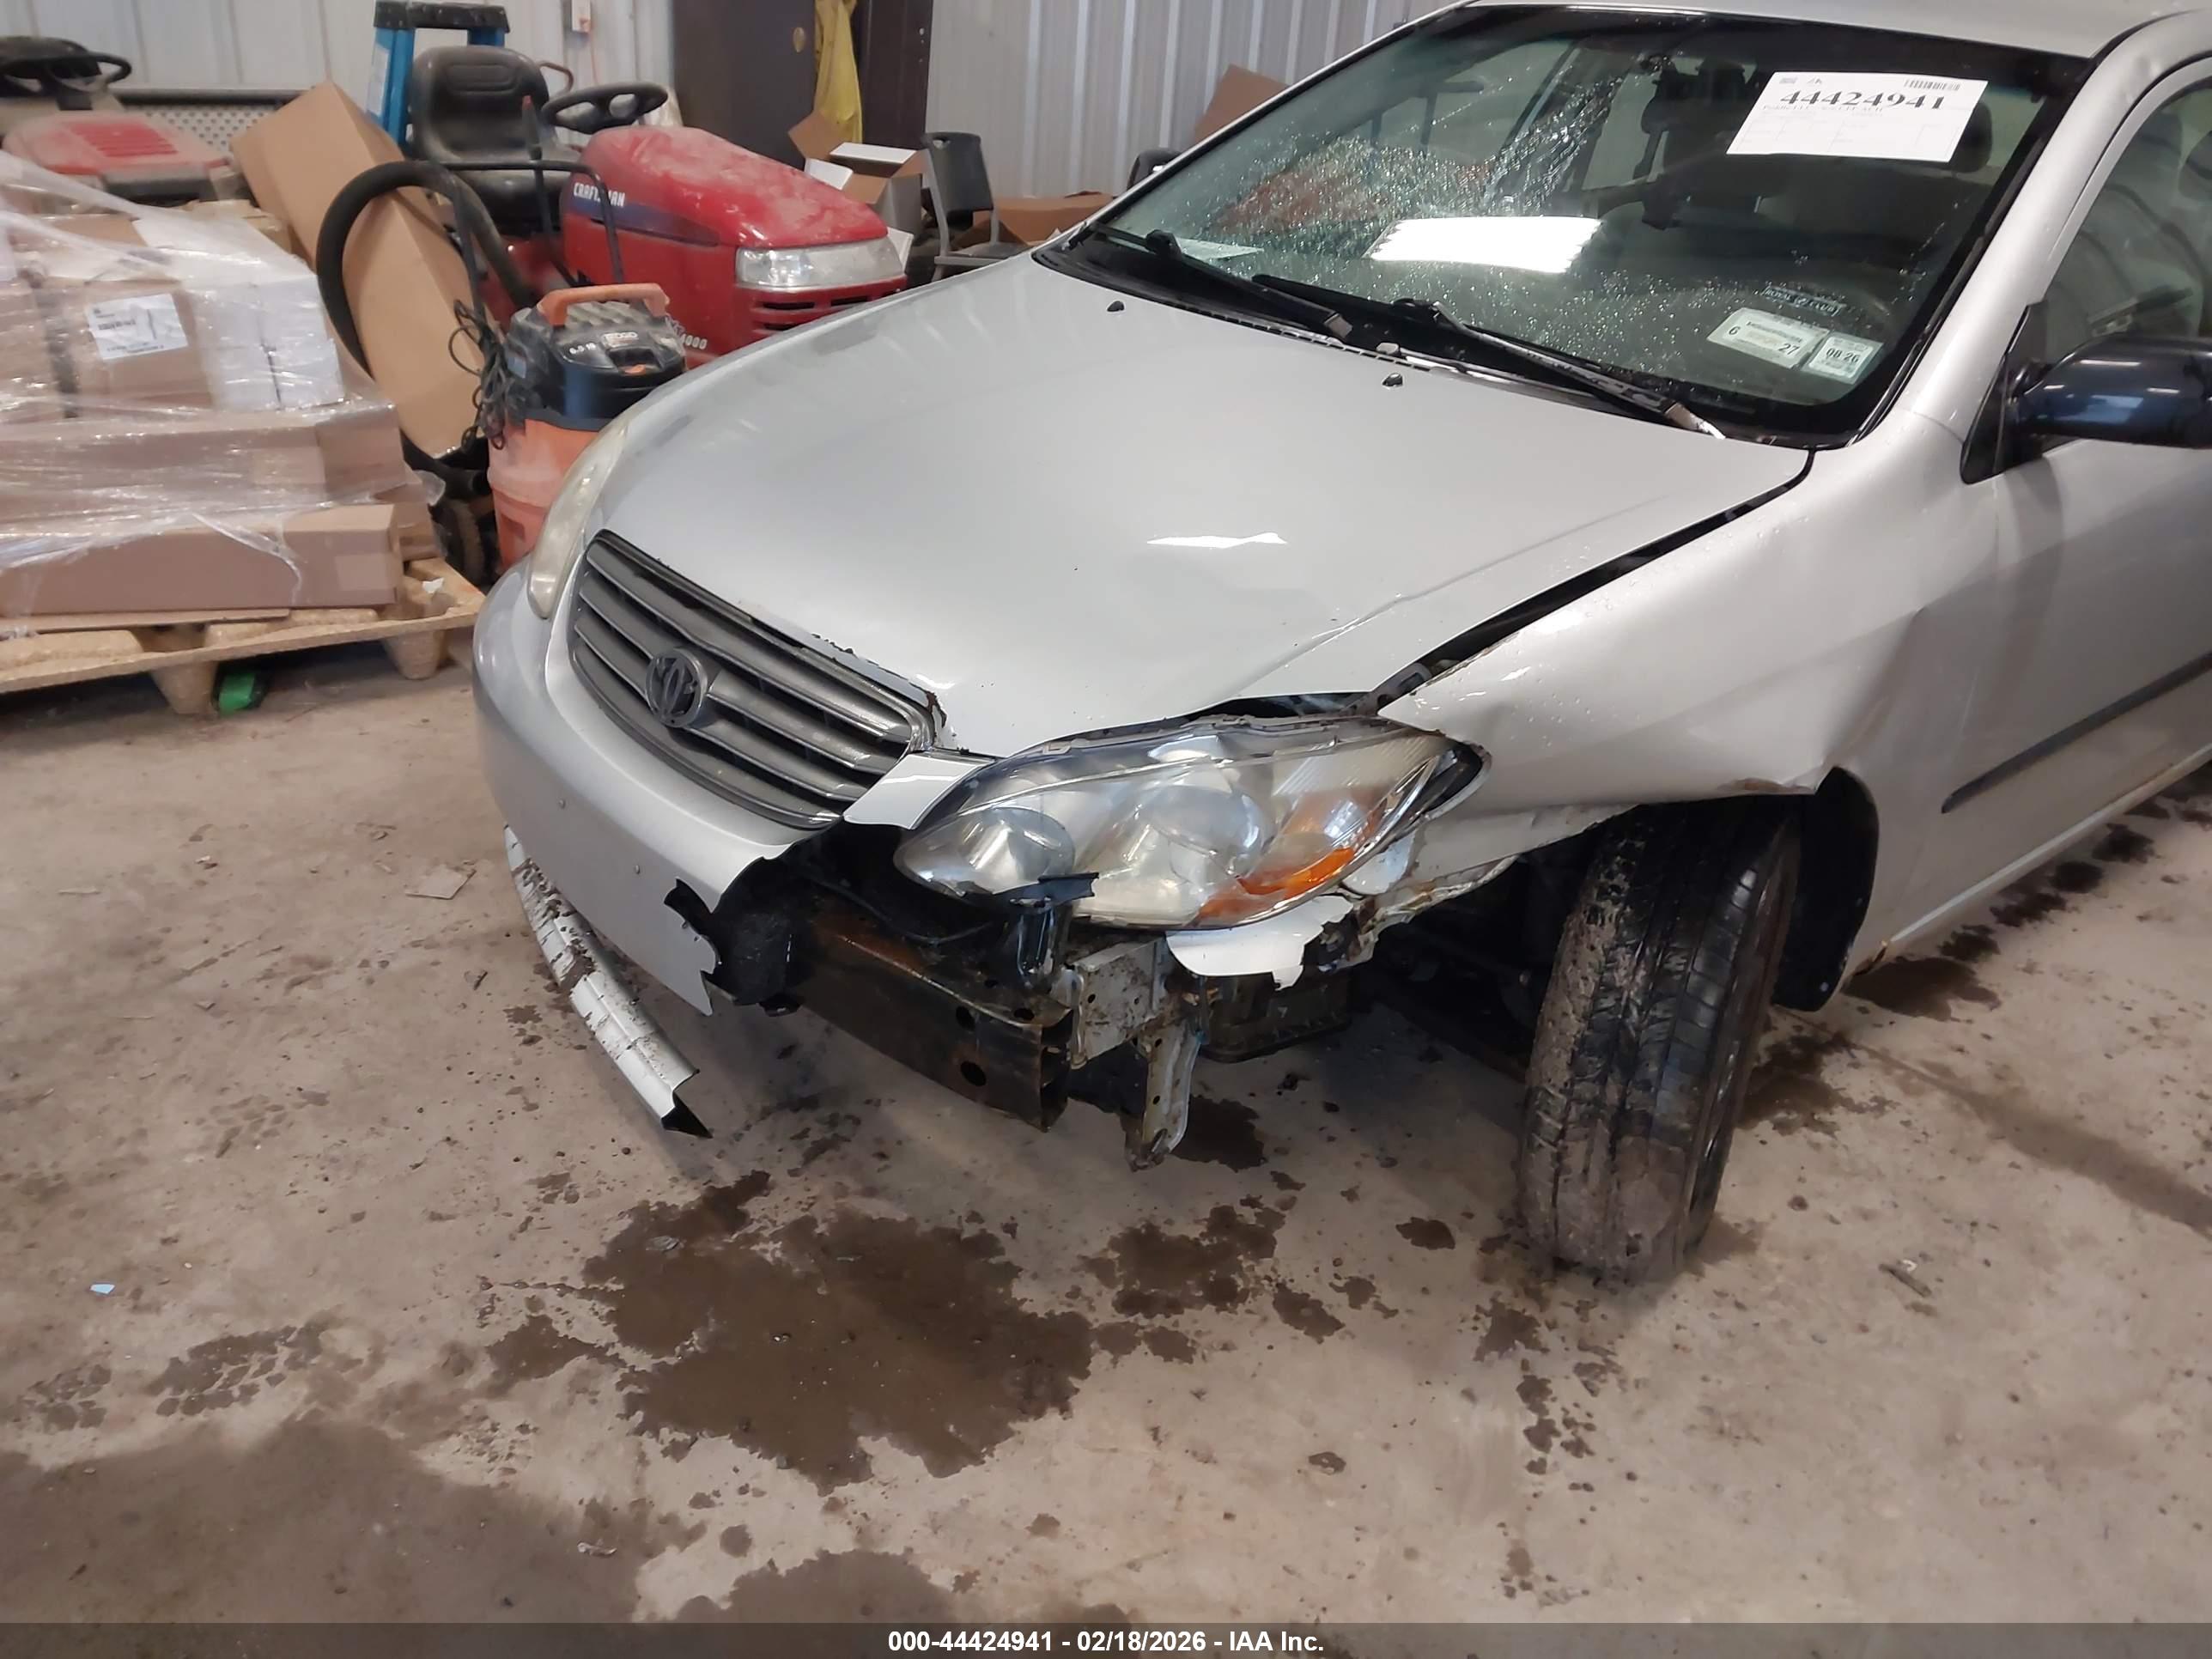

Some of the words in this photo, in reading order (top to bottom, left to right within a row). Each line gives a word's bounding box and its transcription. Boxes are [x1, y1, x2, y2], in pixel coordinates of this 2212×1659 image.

[1779, 89, 1946, 110] 44424941
[574, 182, 625, 208] CRAFTAN
[1778, 343, 1801, 356] 27
[1844, 352, 1861, 364] 26
